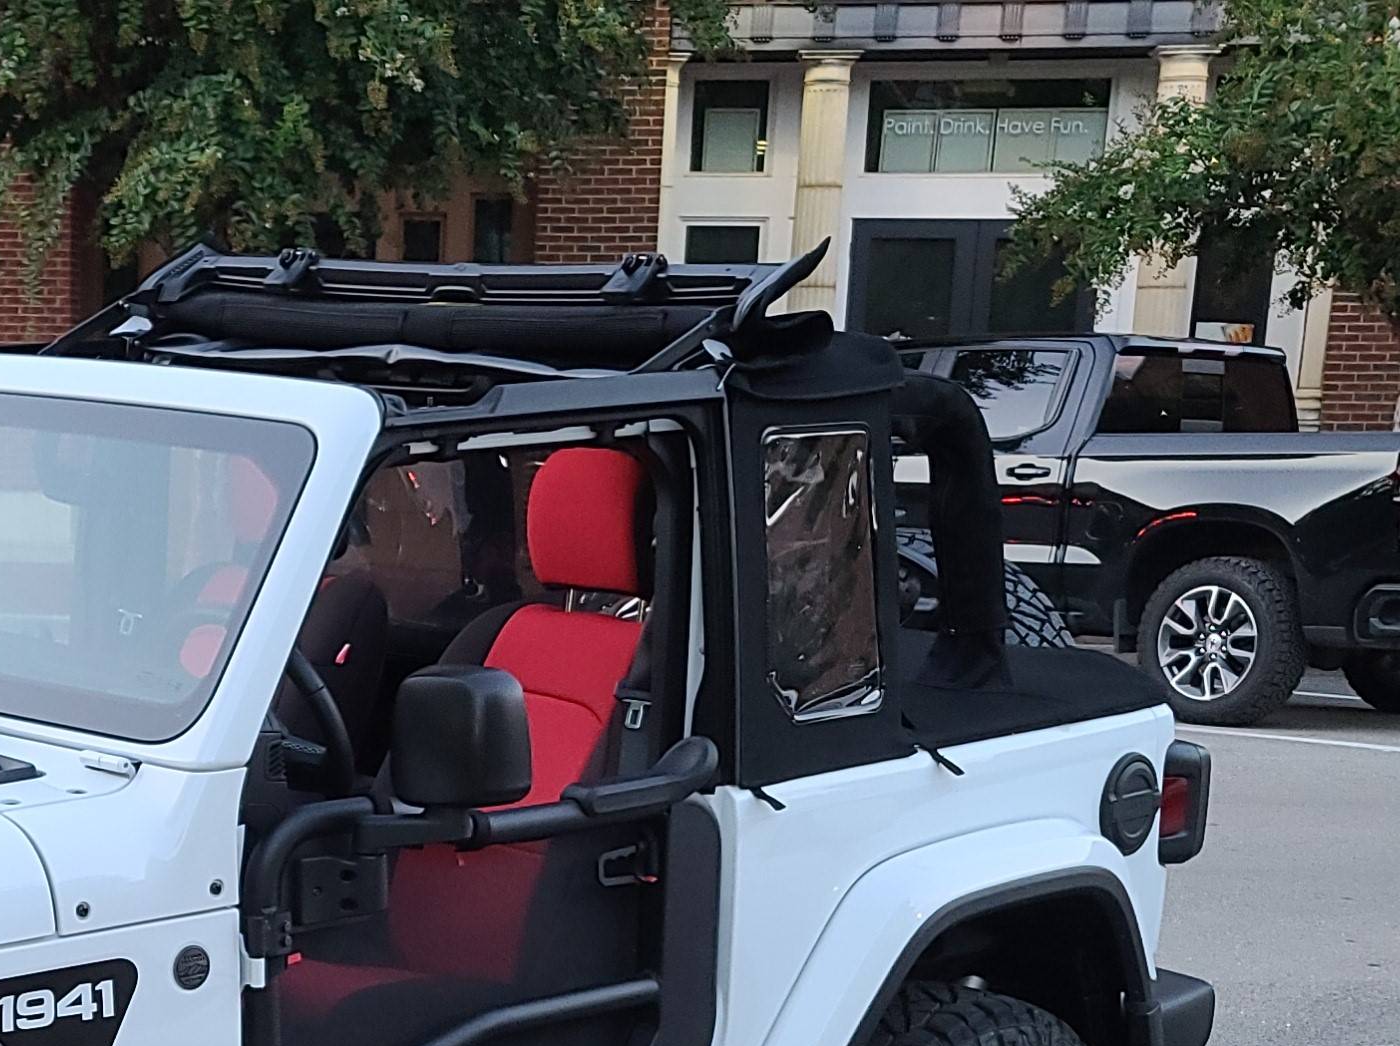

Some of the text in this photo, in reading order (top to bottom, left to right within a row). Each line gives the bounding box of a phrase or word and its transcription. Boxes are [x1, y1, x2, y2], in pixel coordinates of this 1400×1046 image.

[884, 117, 1089, 135] Paint. Drink. Have Fun.
